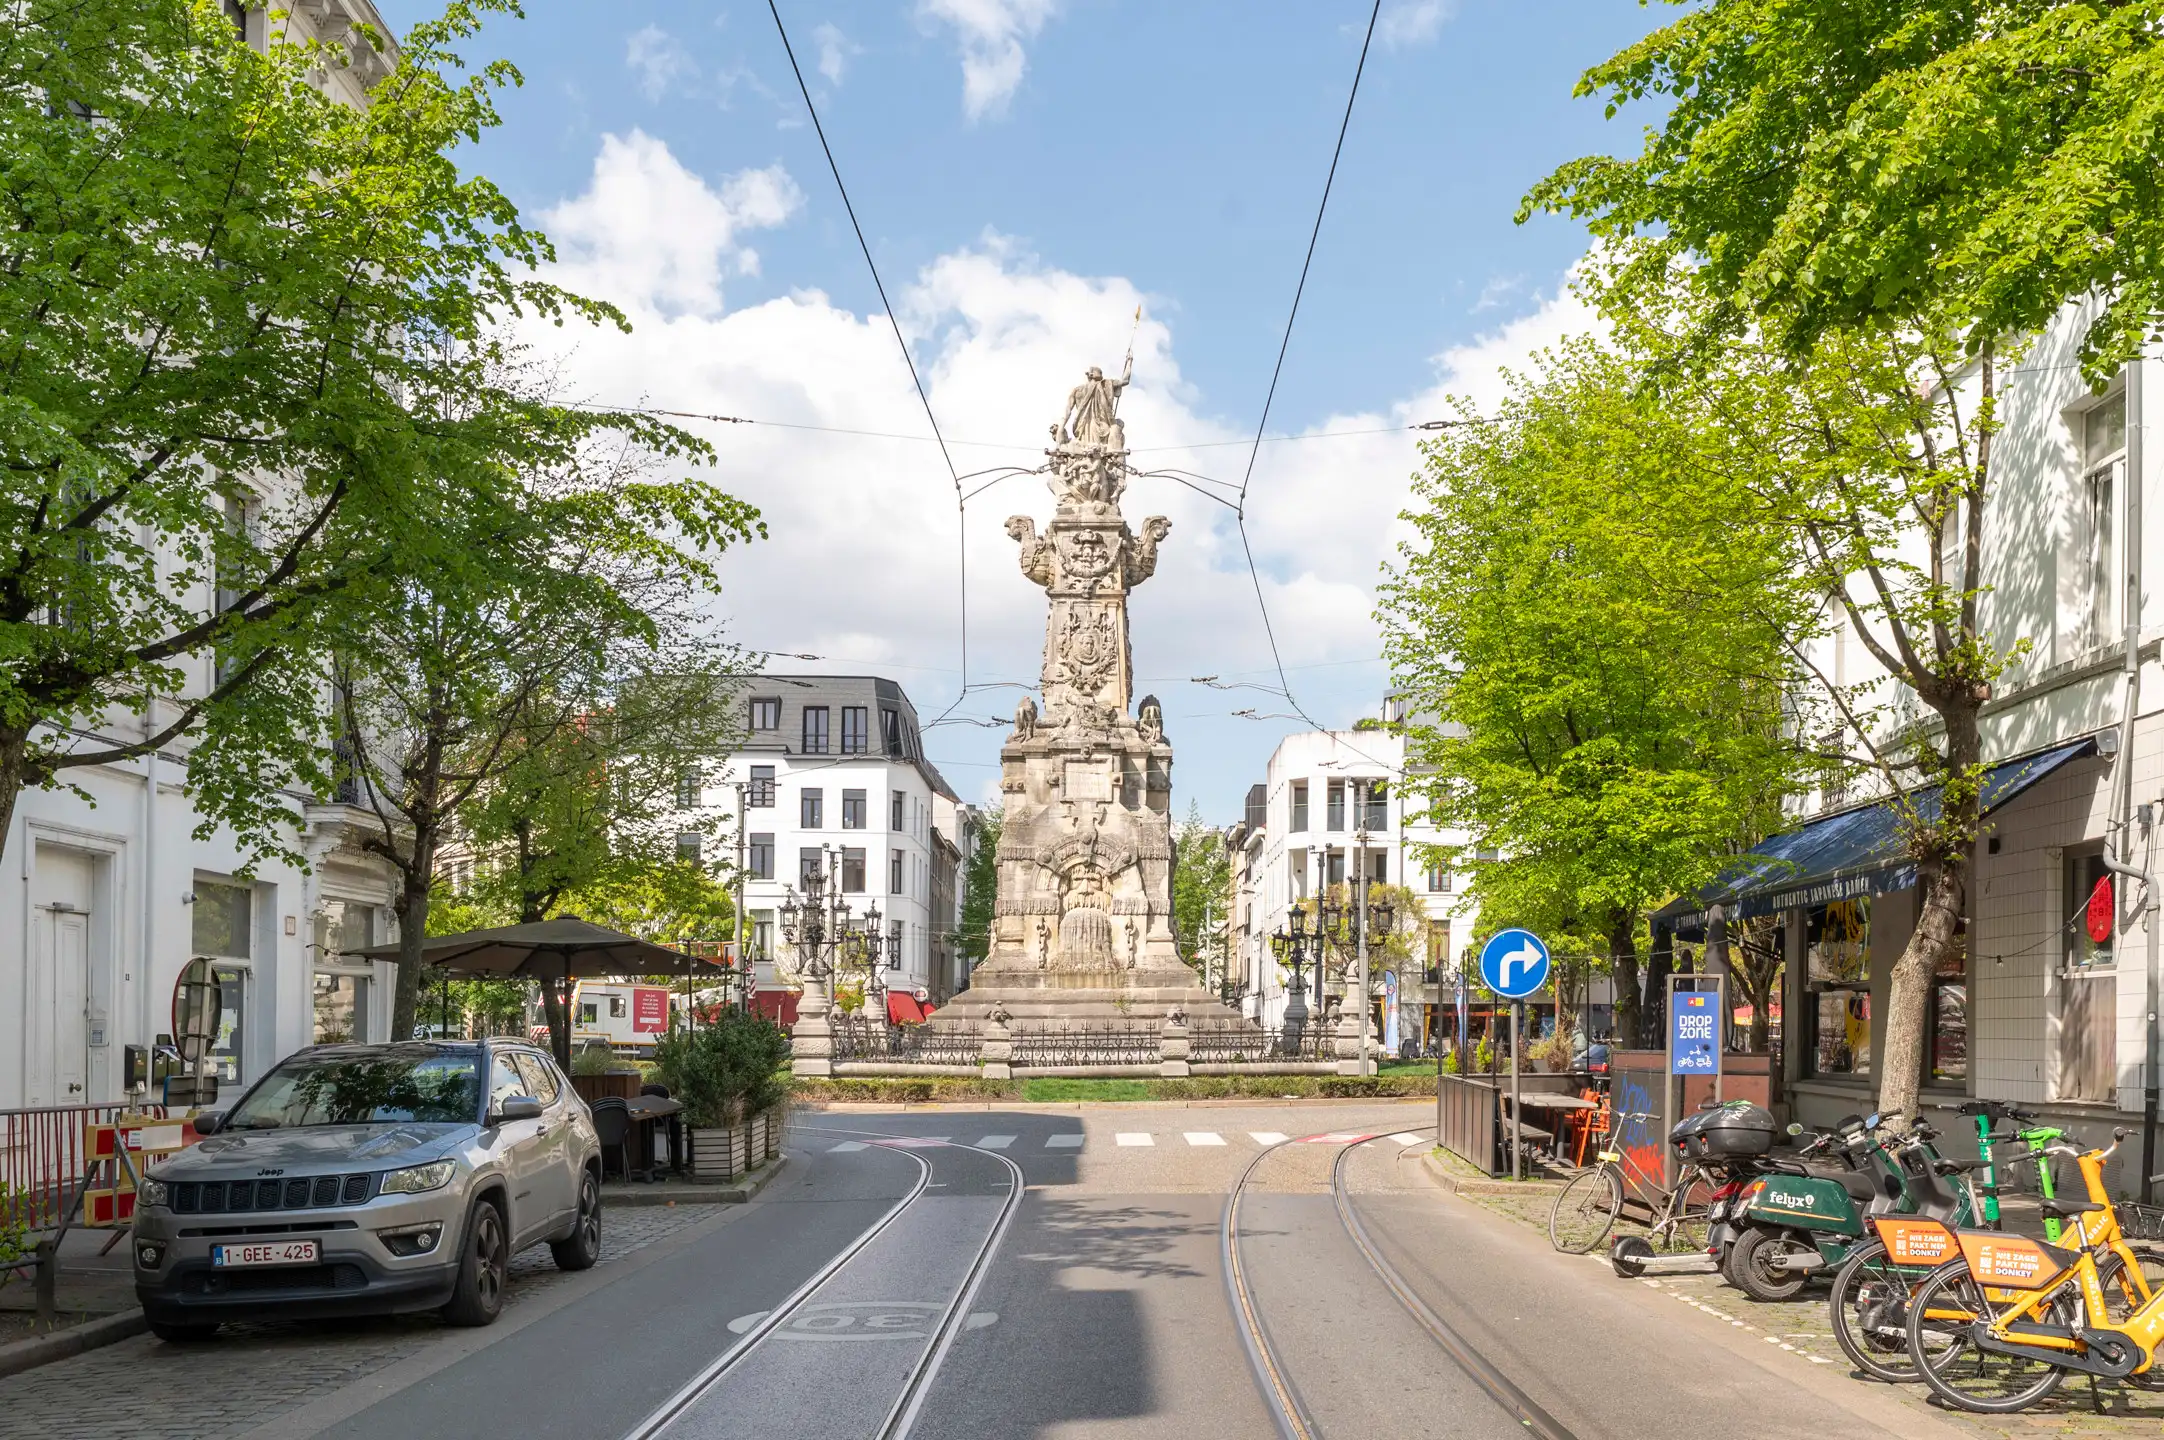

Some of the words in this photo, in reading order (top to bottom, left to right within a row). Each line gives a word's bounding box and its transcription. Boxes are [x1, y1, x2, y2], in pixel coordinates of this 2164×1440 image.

[1773, 890, 1808, 909] AUTHENTIC
[1810, 883, 1843, 902] JAPANESE
[1846, 876, 1870, 896] RAMEN
[1679, 1015, 1713, 1027] DROP
[1679, 1027, 1712, 1039] ZONE
[257, 1168, 284, 1176] Jeep
[1770, 1191, 1805, 1208] felyx
[1909, 1249, 1942, 1257] DONKEY
[1995, 1260, 2019, 1268] PAKT
[1995, 1267, 2032, 1278] DONKEY
